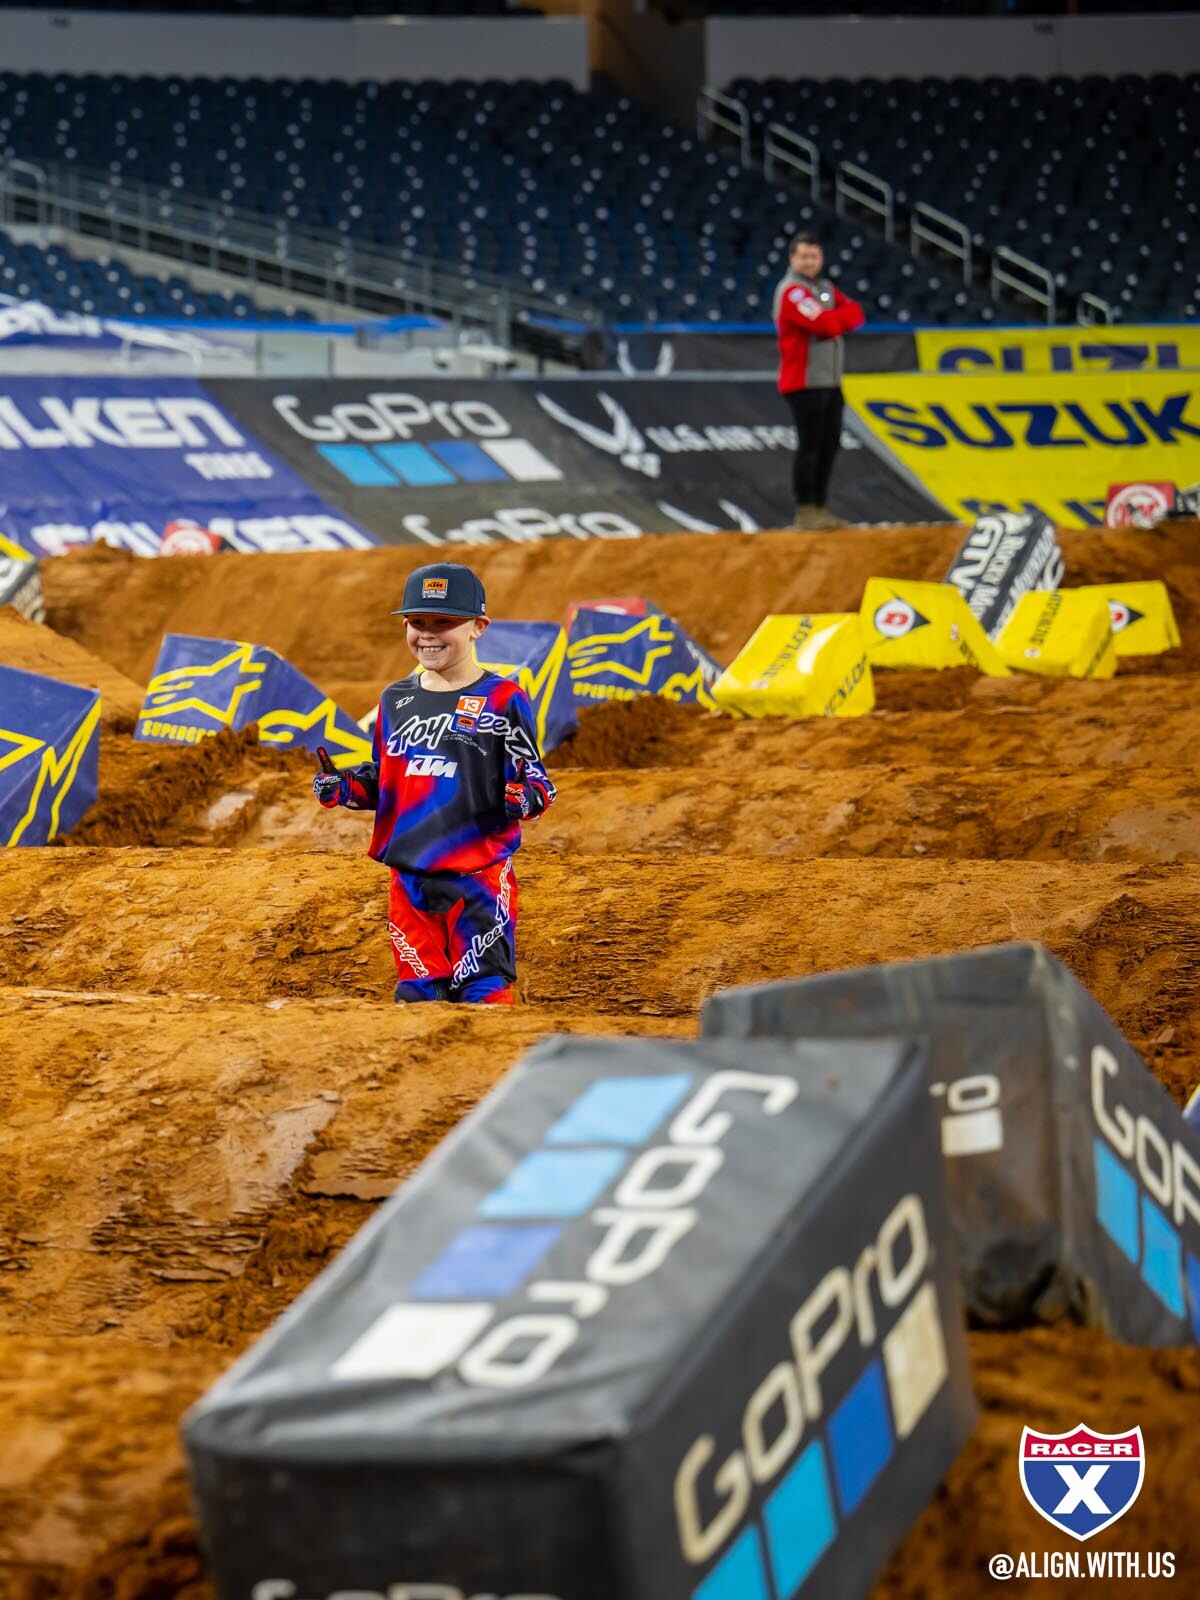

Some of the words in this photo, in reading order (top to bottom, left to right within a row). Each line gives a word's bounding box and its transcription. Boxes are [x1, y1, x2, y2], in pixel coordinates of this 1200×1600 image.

[272, 393, 511, 441] GoPro
[864, 393, 1200, 448] SUZUK
[463, 699, 480, 712] 13
[405, 755, 458, 778] KTM
[460, 1069, 799, 1387] GoPro
[674, 1194, 929, 1565] GoPro
